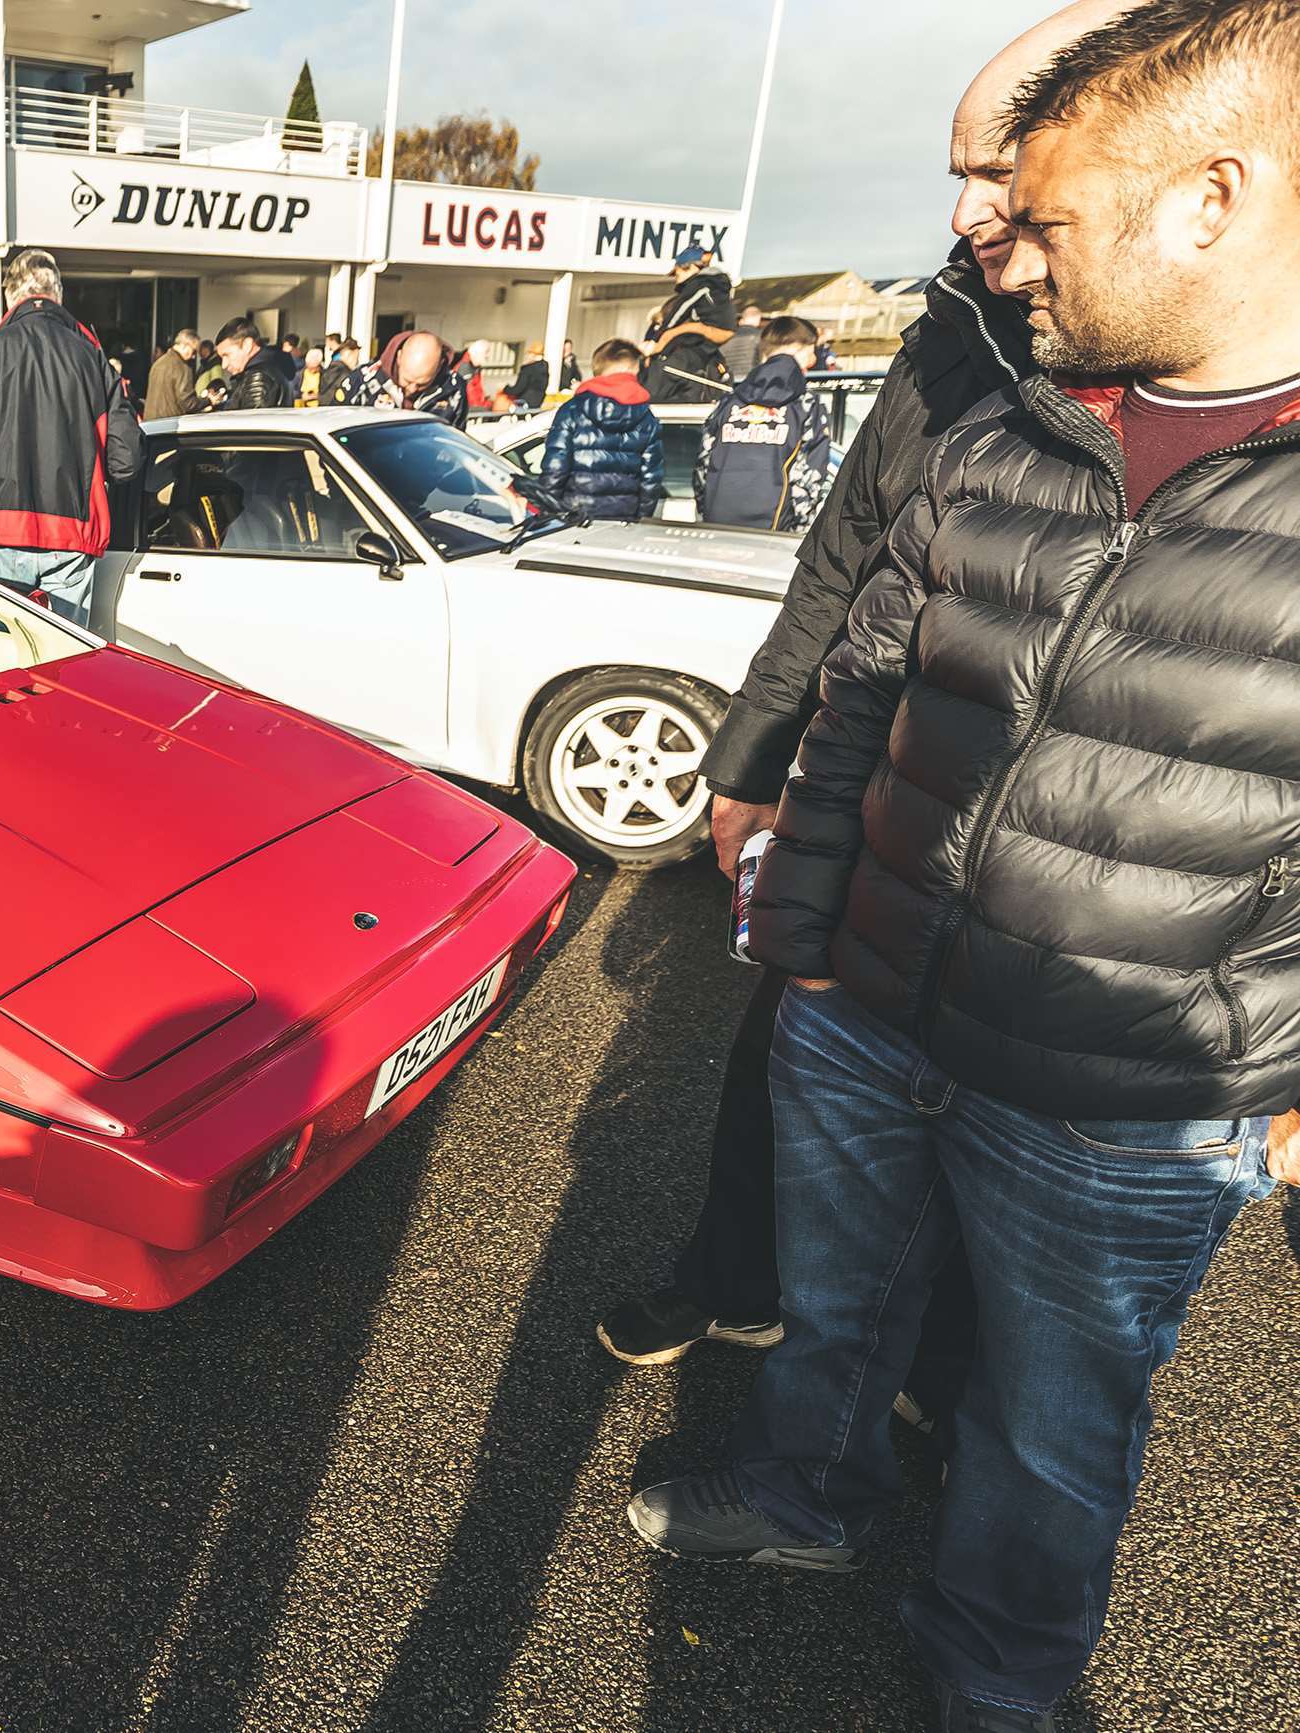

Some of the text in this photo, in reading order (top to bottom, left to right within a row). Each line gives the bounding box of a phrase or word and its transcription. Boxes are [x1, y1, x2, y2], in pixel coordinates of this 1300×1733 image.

[111, 183, 311, 234] DUNLOP
[422, 202, 548, 252] LUCAS
[595, 216, 729, 263] MINTEX
[383, 969, 496, 1097] D521 FAH
